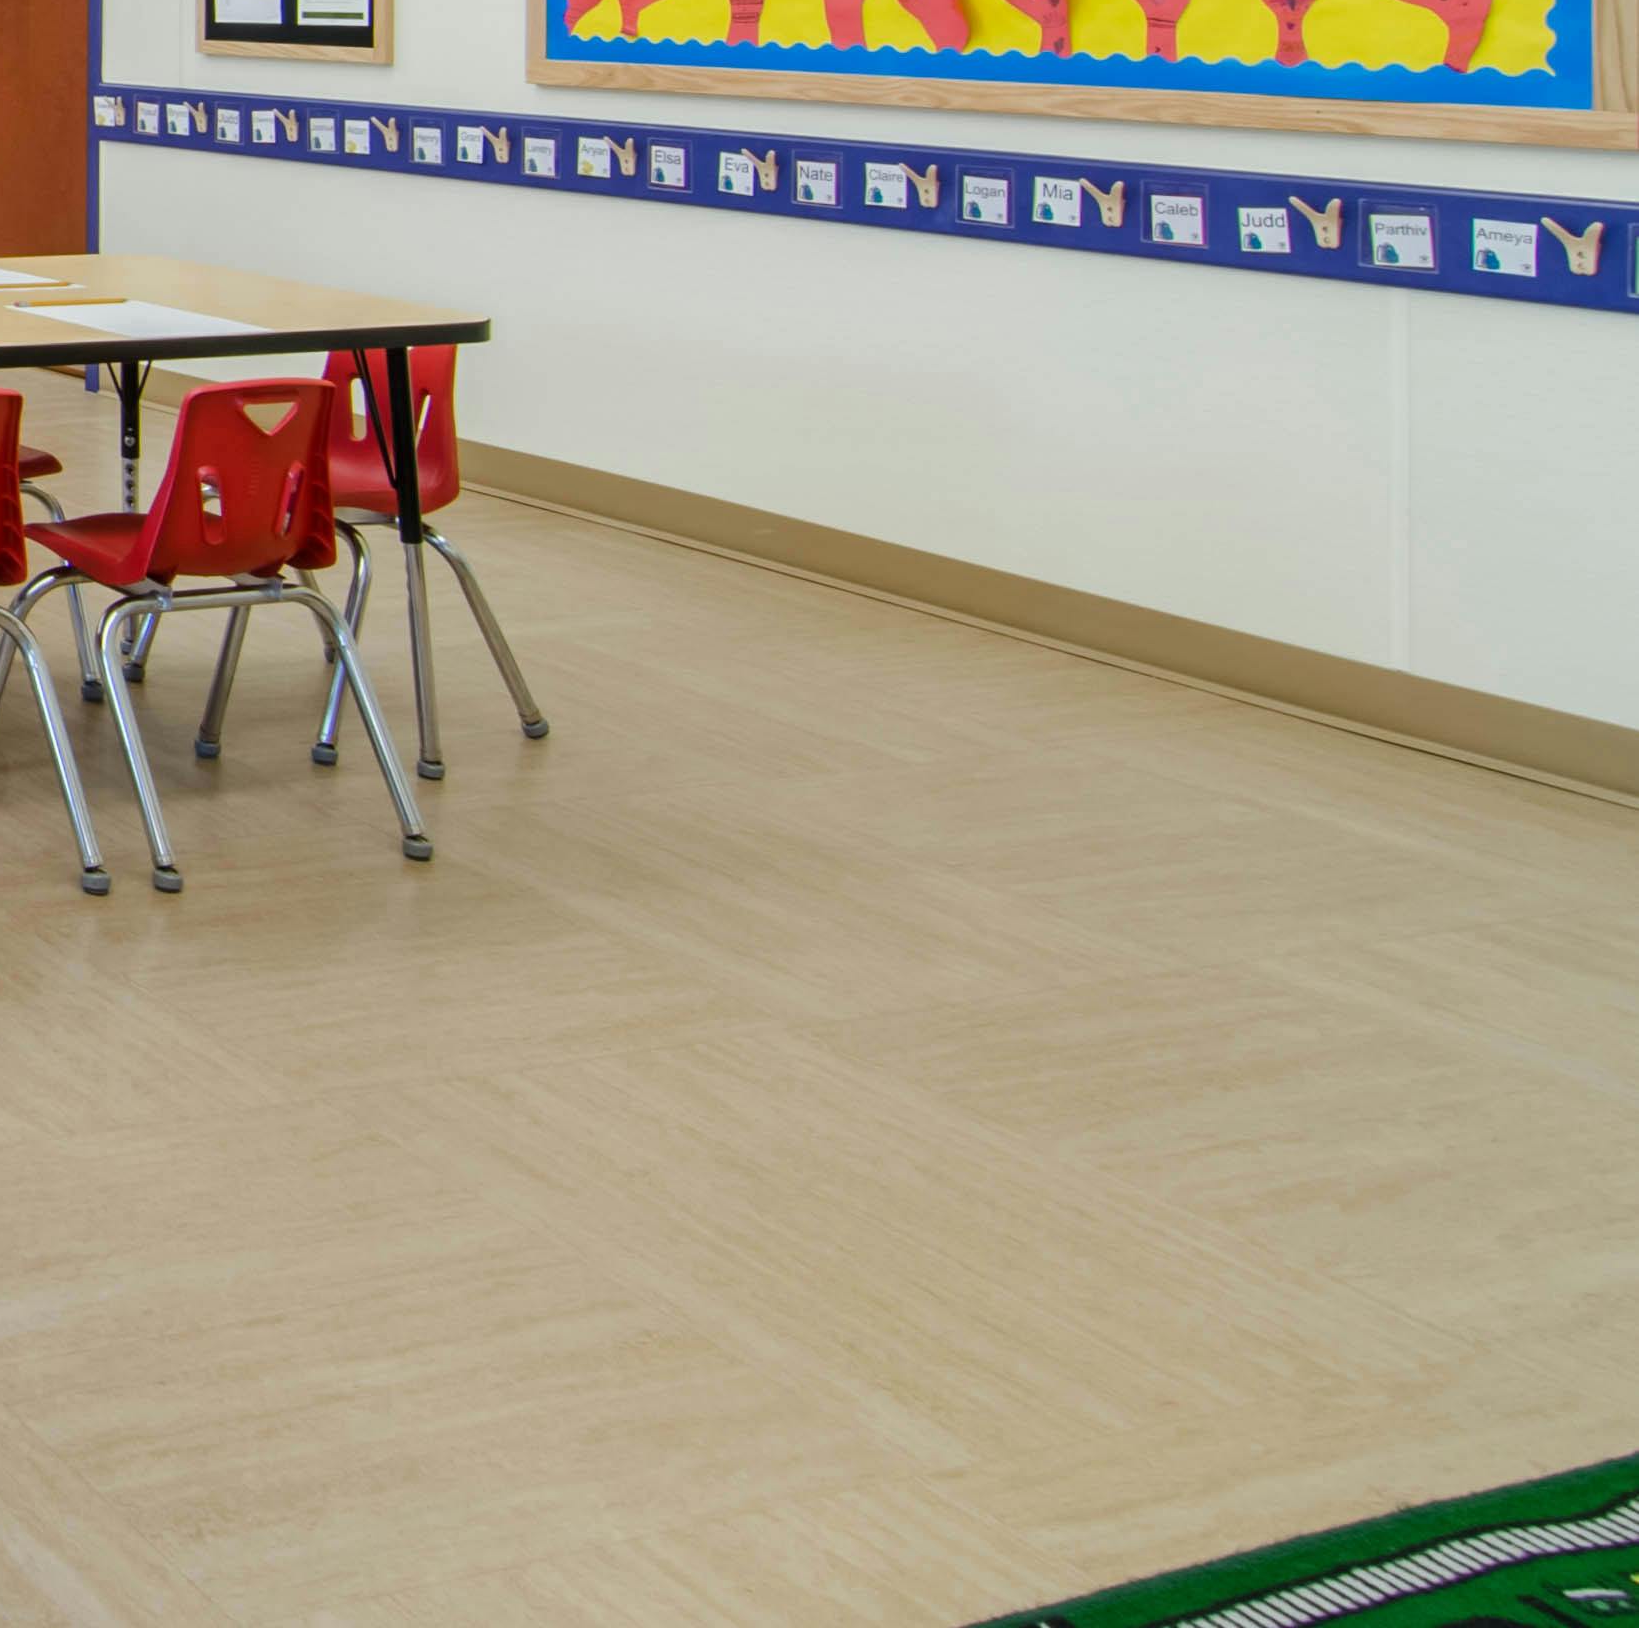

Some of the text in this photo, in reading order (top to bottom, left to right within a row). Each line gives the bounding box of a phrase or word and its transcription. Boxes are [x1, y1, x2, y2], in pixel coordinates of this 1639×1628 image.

[581, 143, 608, 158] Aryan
[654, 149, 681, 165] Elsa
[724, 157, 750, 173] Eva
[799, 166, 833, 182] Nate
[869, 168, 904, 183] Claire
[965, 182, 1006, 199] Logan
[1042, 183, 1074, 200] Mia
[1154, 201, 1199, 217] Caleb
[1242, 212, 1286, 229] Judd
[1374, 222, 1427, 237] Parthiv
[1475, 227, 1534, 246] Ameya
